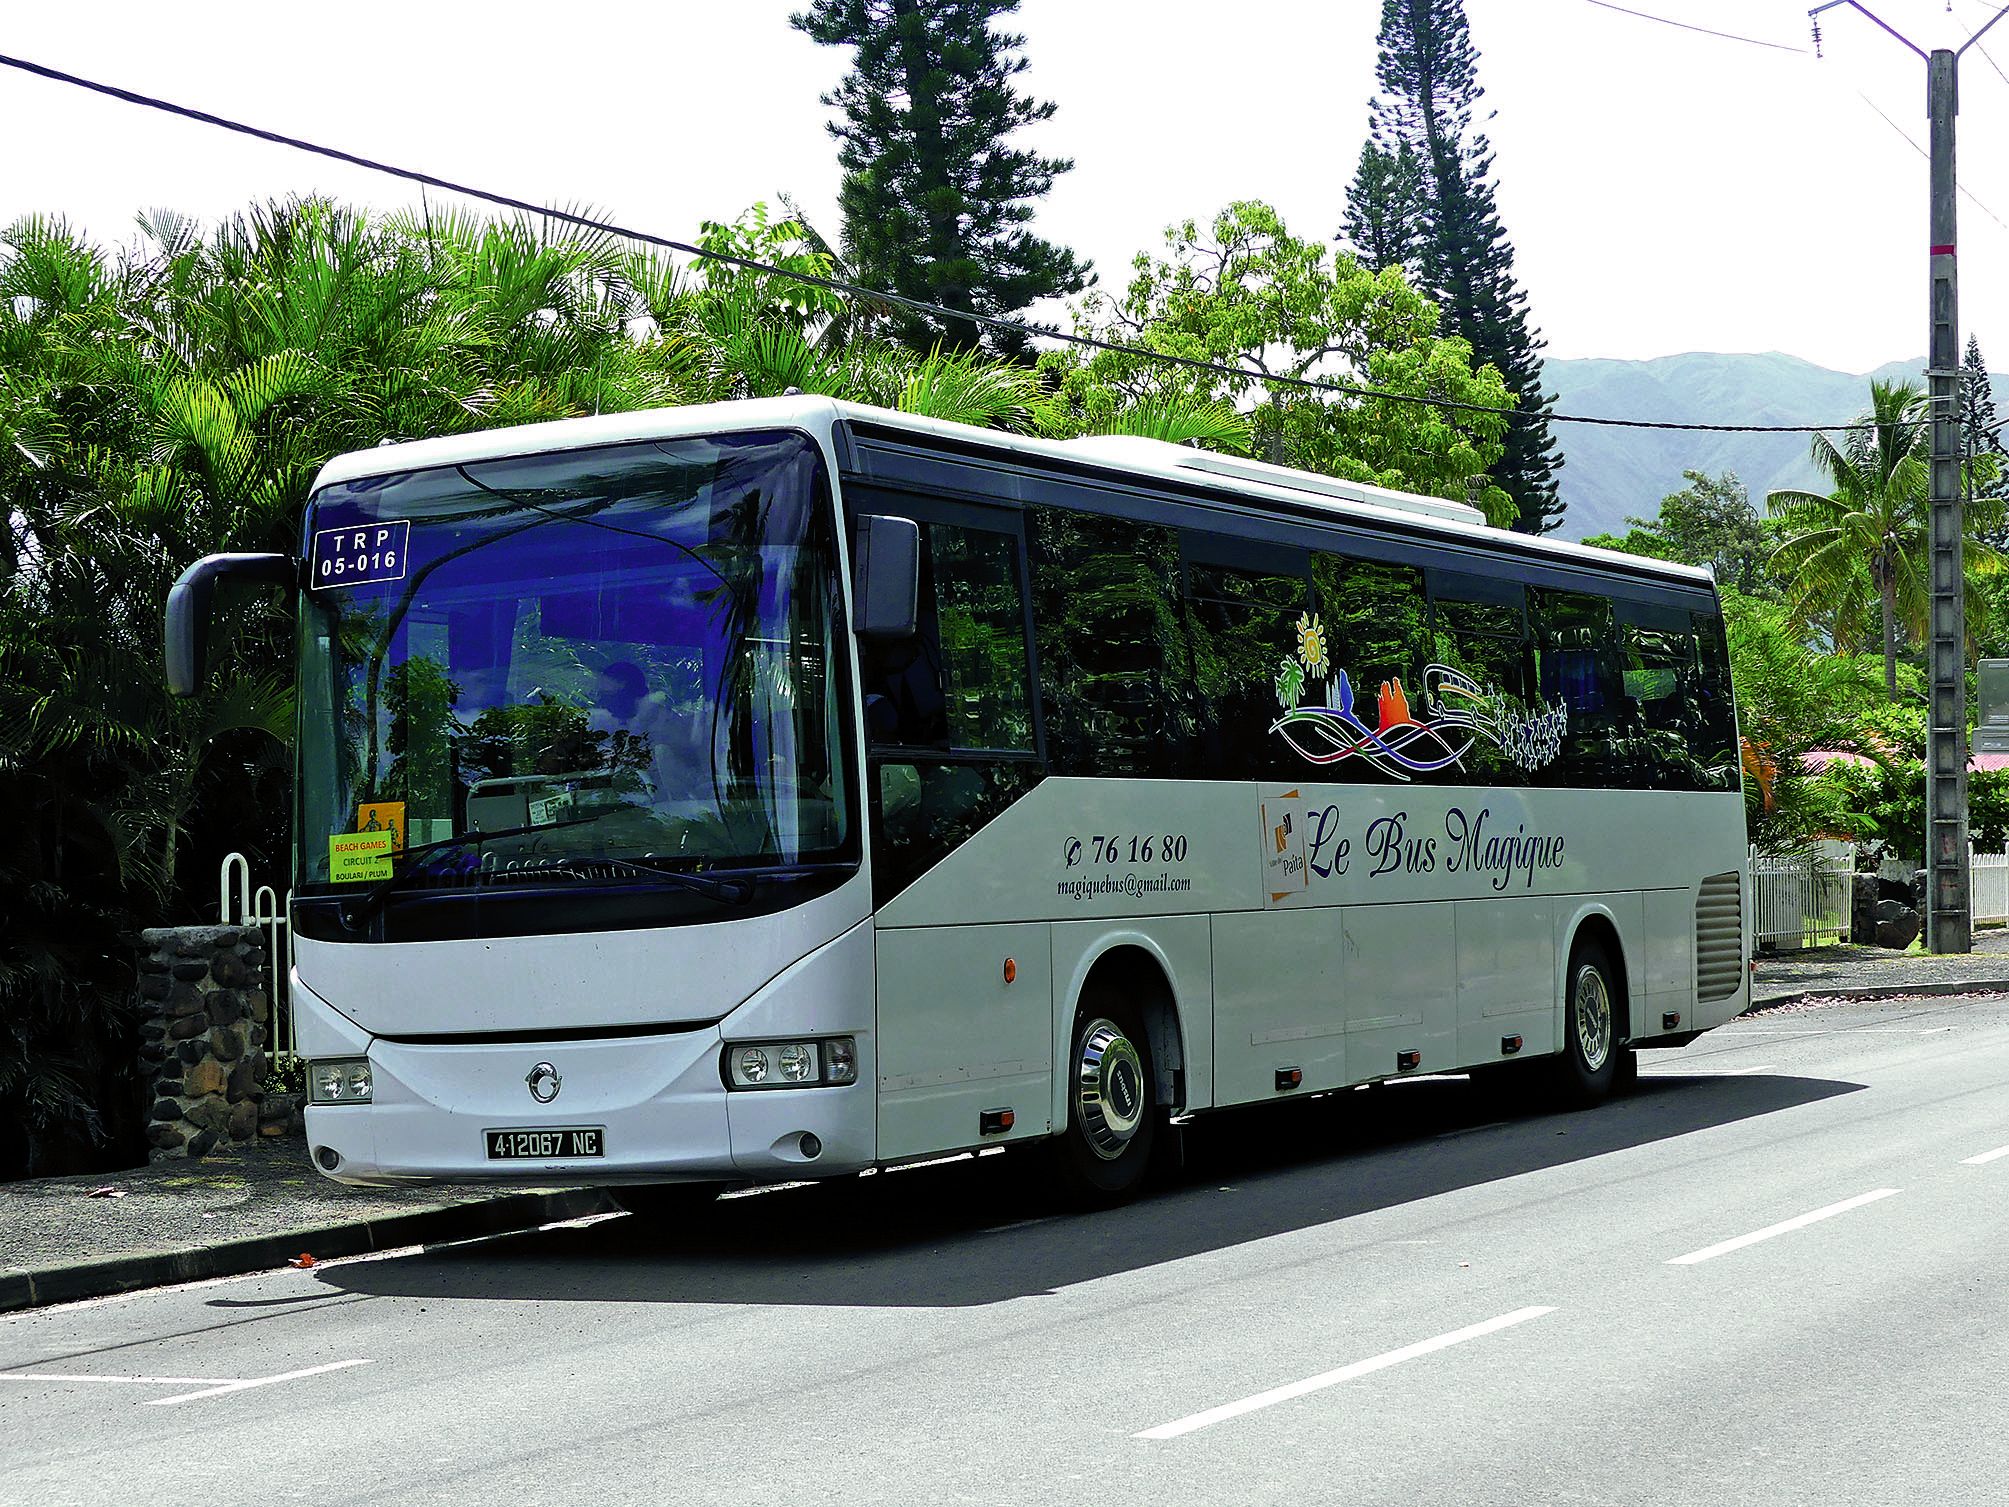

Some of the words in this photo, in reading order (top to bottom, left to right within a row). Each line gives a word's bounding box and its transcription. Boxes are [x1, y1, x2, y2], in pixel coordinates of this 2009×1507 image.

[321, 551, 396, 577] 05-016
[335, 842, 359, 853] BEACH
[360, 840, 387, 851] GAMES
[1091, 835, 1120, 864] 76
[1127, 835, 1154, 863] 16
[1161, 834, 1188, 862] 80
[1307, 804, 1351, 879] Le
[1365, 811, 1437, 878] Bus
[1445, 807, 1565, 891] Magique
[343, 856, 372, 867] CIRCUIT
[335, 871, 363, 881] BOULARI
[368, 869, 388, 879] PLUM
[1057, 872, 1191, 901] magiquebus@gmail.com
[495, 1133, 563, 1156] 412067
[572, 1132, 597, 1155] NC
